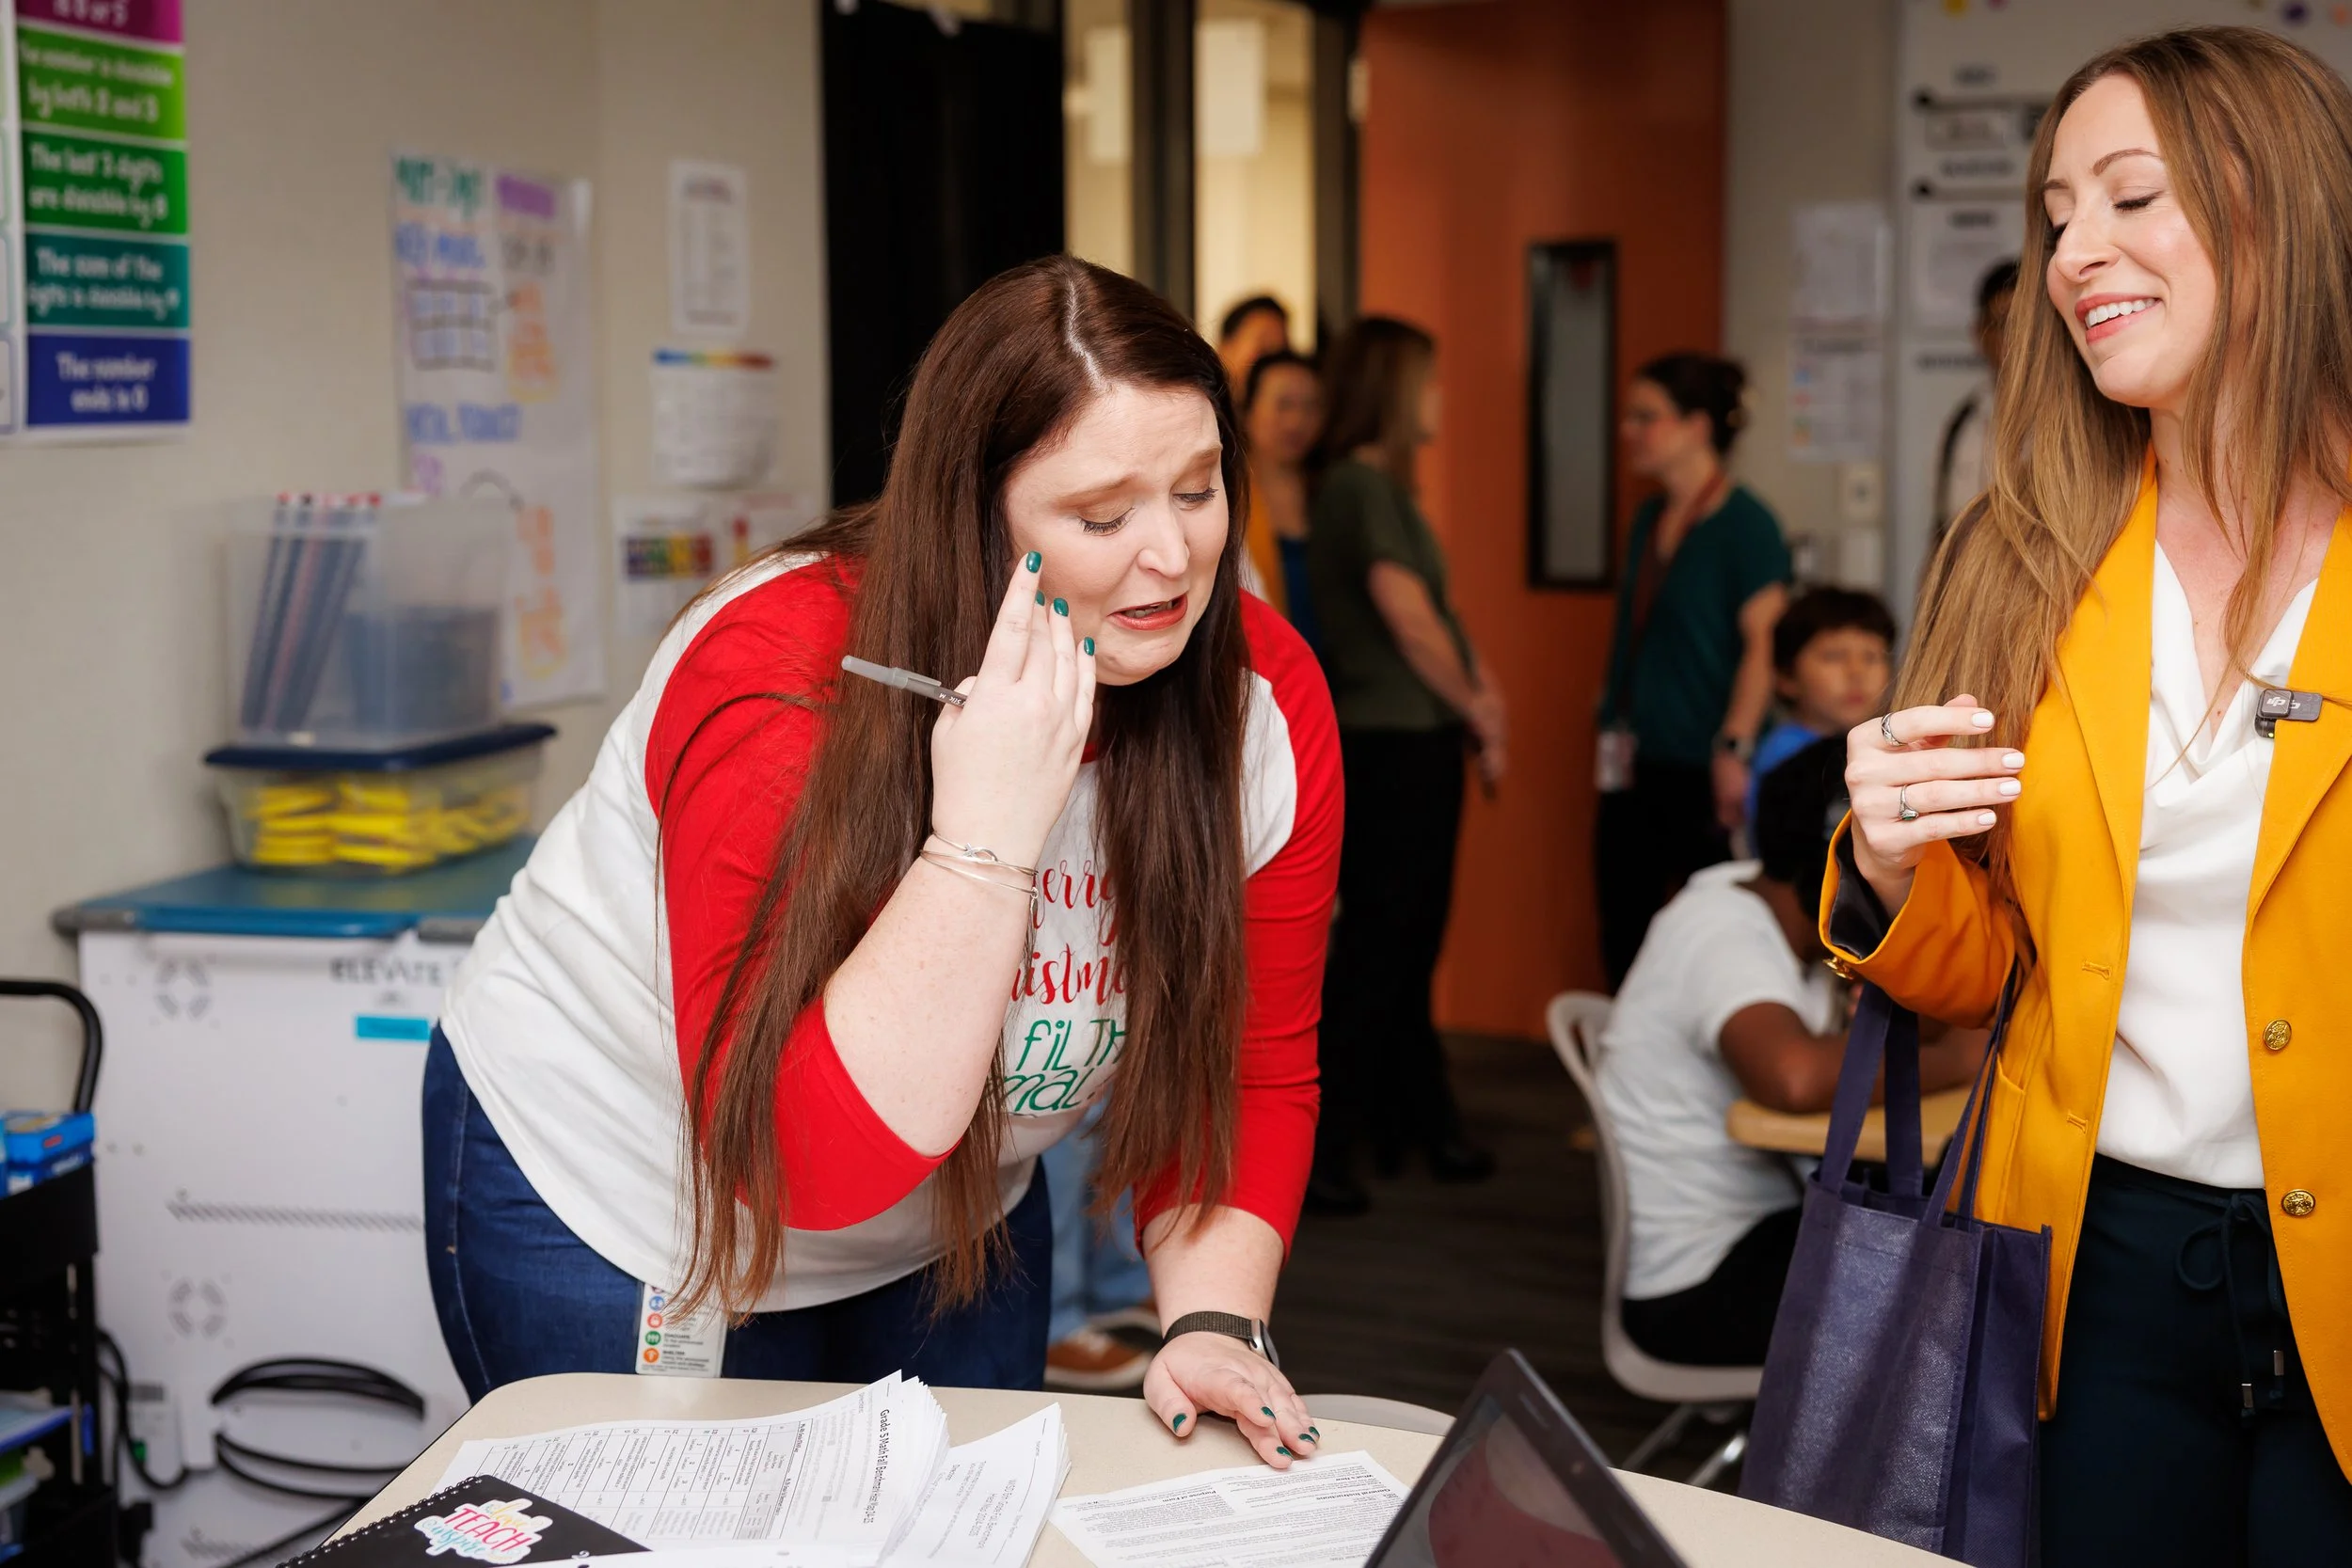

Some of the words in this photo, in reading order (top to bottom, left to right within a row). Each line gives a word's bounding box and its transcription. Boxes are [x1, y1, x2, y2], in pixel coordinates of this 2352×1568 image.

[1032, 860, 1119, 946] erry
[880, 1409, 890, 1432] Grade
[878, 1438, 889, 1455] Math
[877, 1455, 888, 1465] Fall
[872, 1465, 886, 1493] Benchmark
[1316, 1492, 1361, 1500] Instructions
[444, 1508, 532, 1552] TEACH
